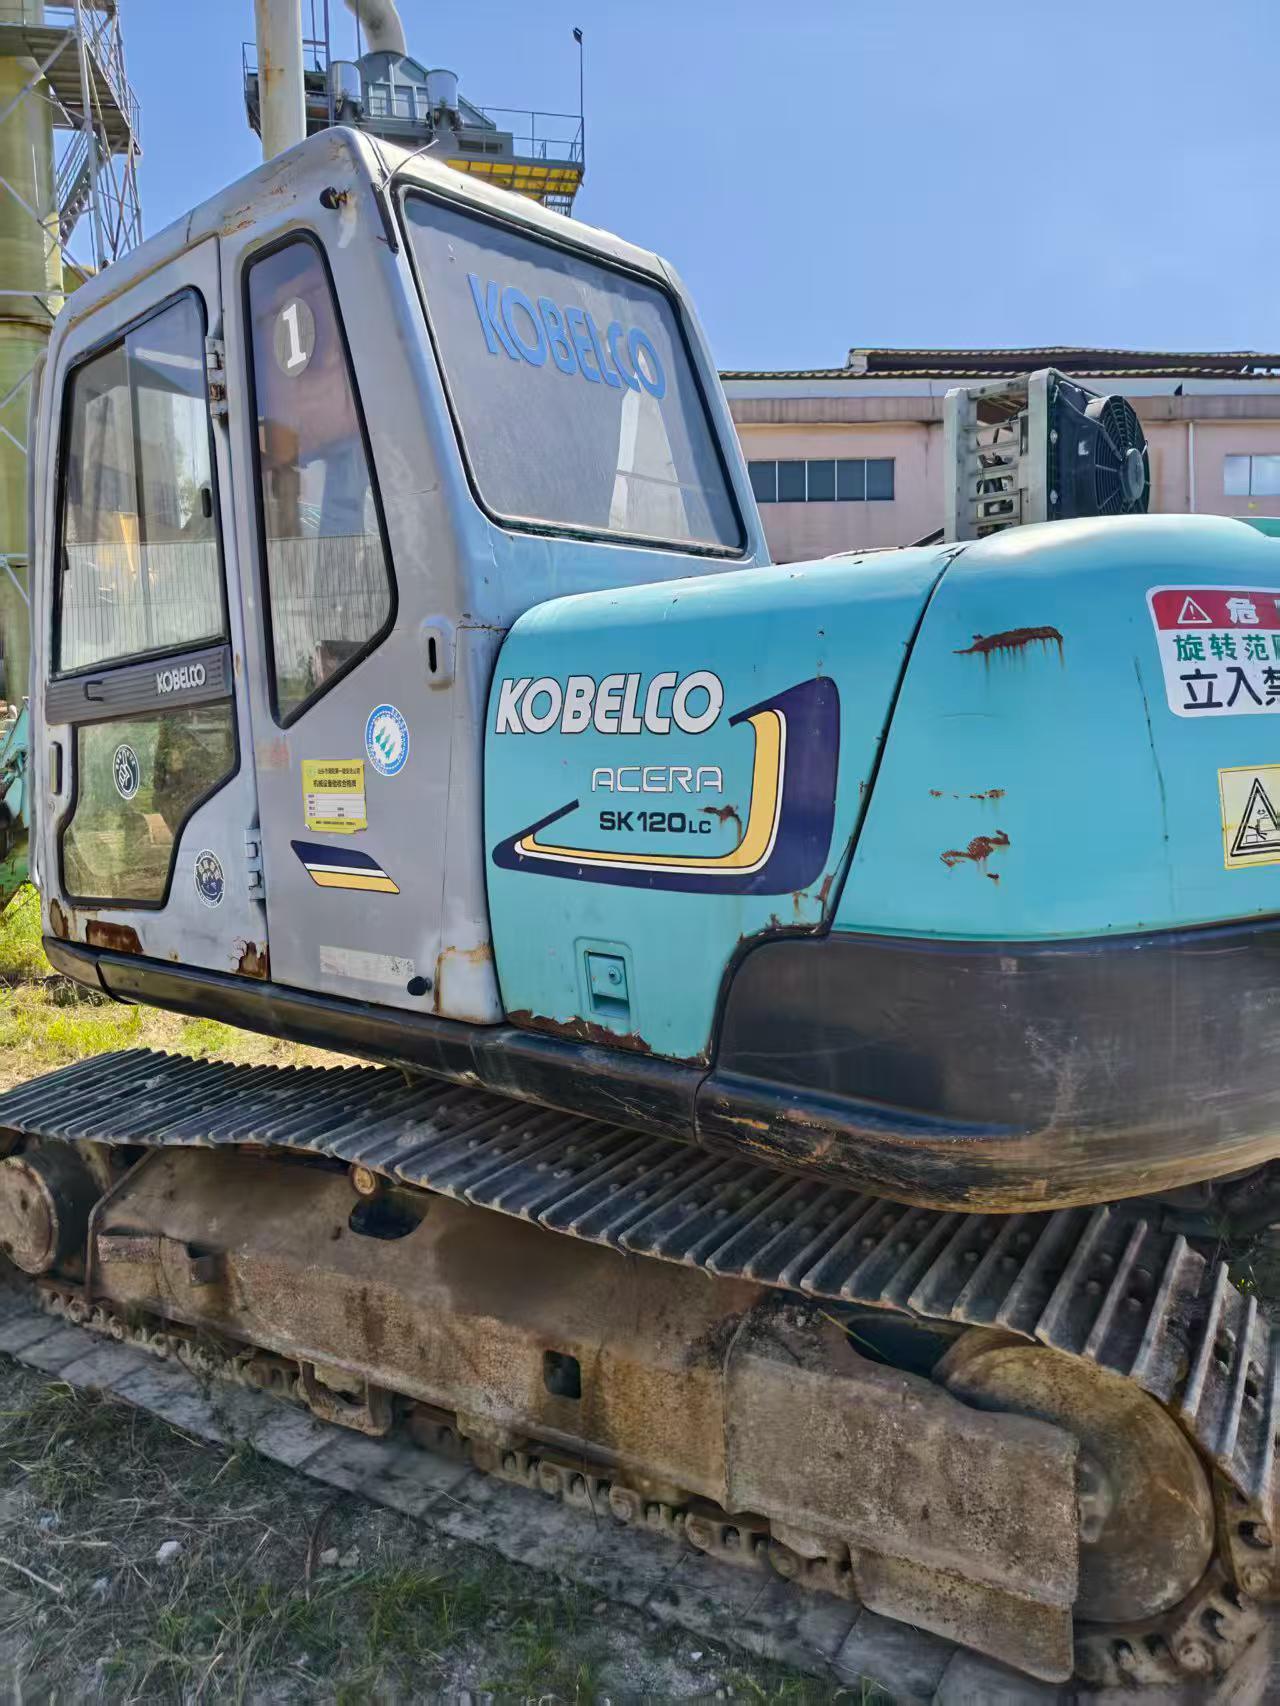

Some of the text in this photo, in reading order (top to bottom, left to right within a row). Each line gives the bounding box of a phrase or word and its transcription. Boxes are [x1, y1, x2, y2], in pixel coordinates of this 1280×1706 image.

[282, 303, 307, 369] 1
[467, 272, 666, 400] KOBELCO
[1225, 597, 1280, 624] 危
[156, 663, 206, 693] KOBELCO
[495, 670, 724, 735] KOBELCO
[591, 766, 723, 793] ACERA
